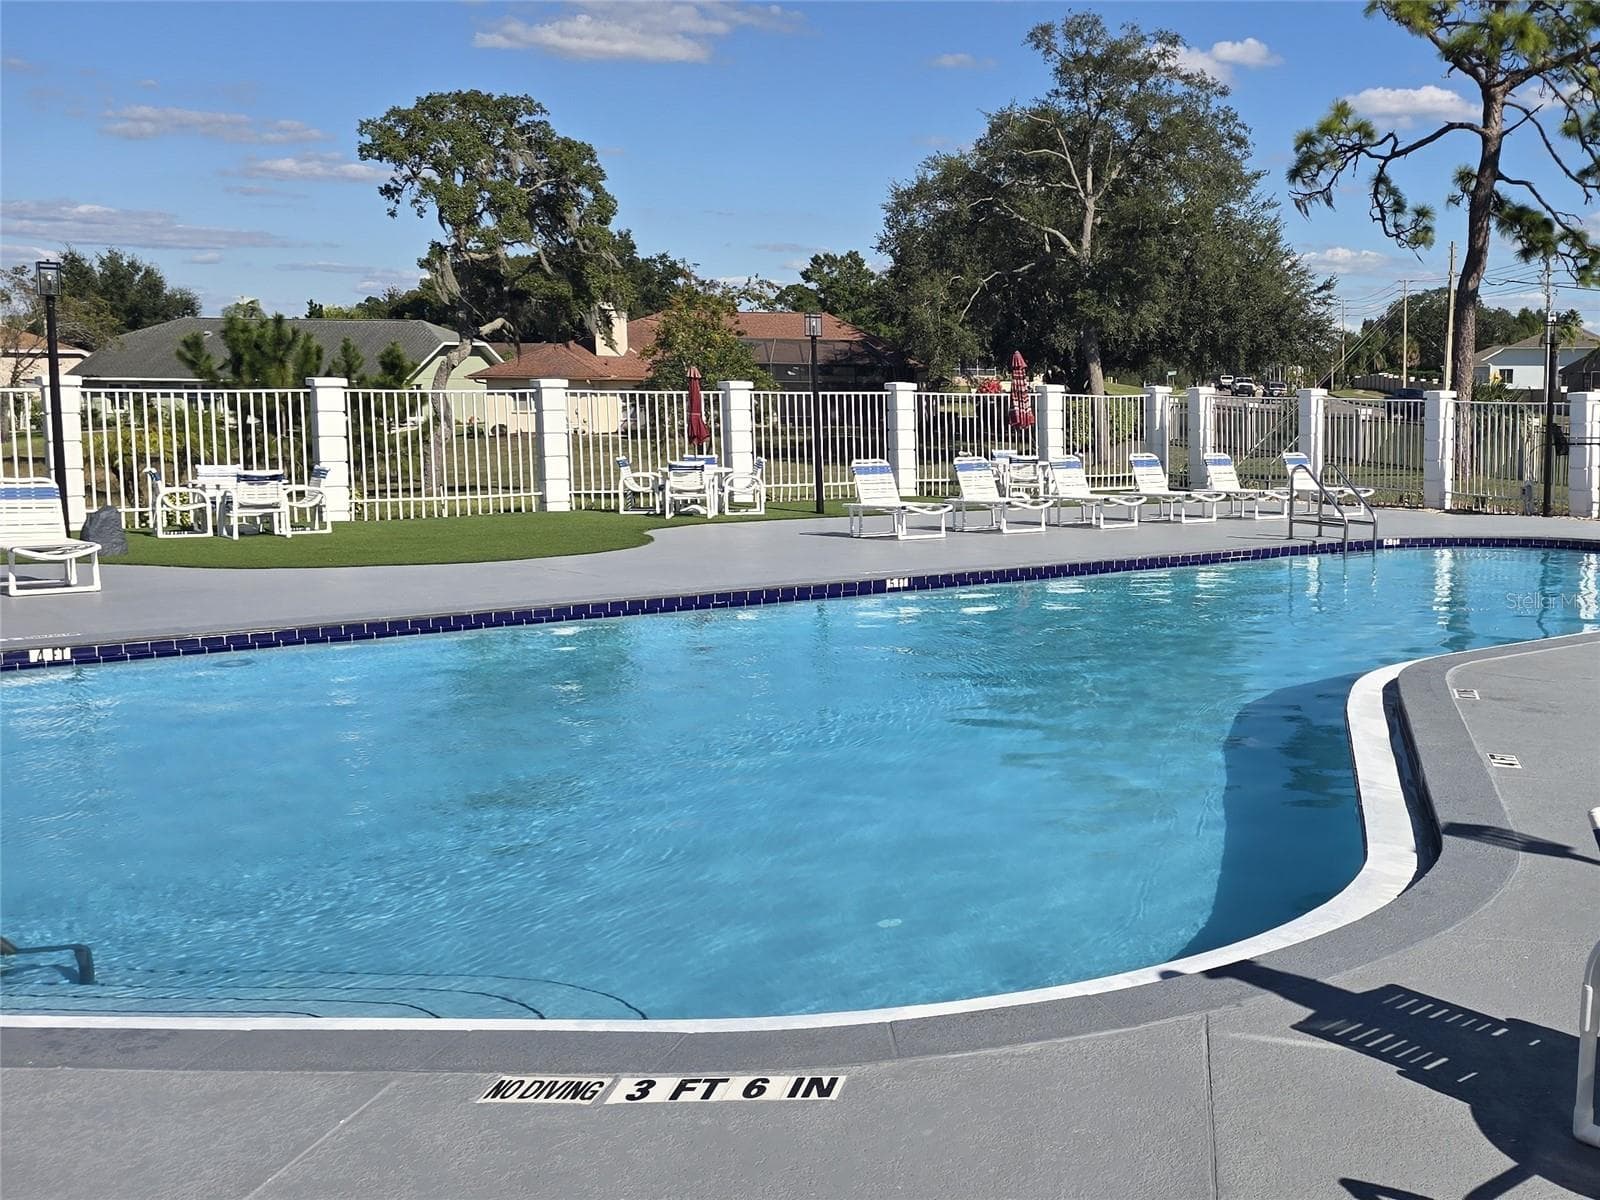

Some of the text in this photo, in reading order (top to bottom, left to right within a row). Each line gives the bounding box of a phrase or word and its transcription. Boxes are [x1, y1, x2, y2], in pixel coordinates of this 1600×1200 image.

[483, 1079, 606, 1101] NO DIVING
[625, 1076, 839, 1102] 3 FT 6 IN
